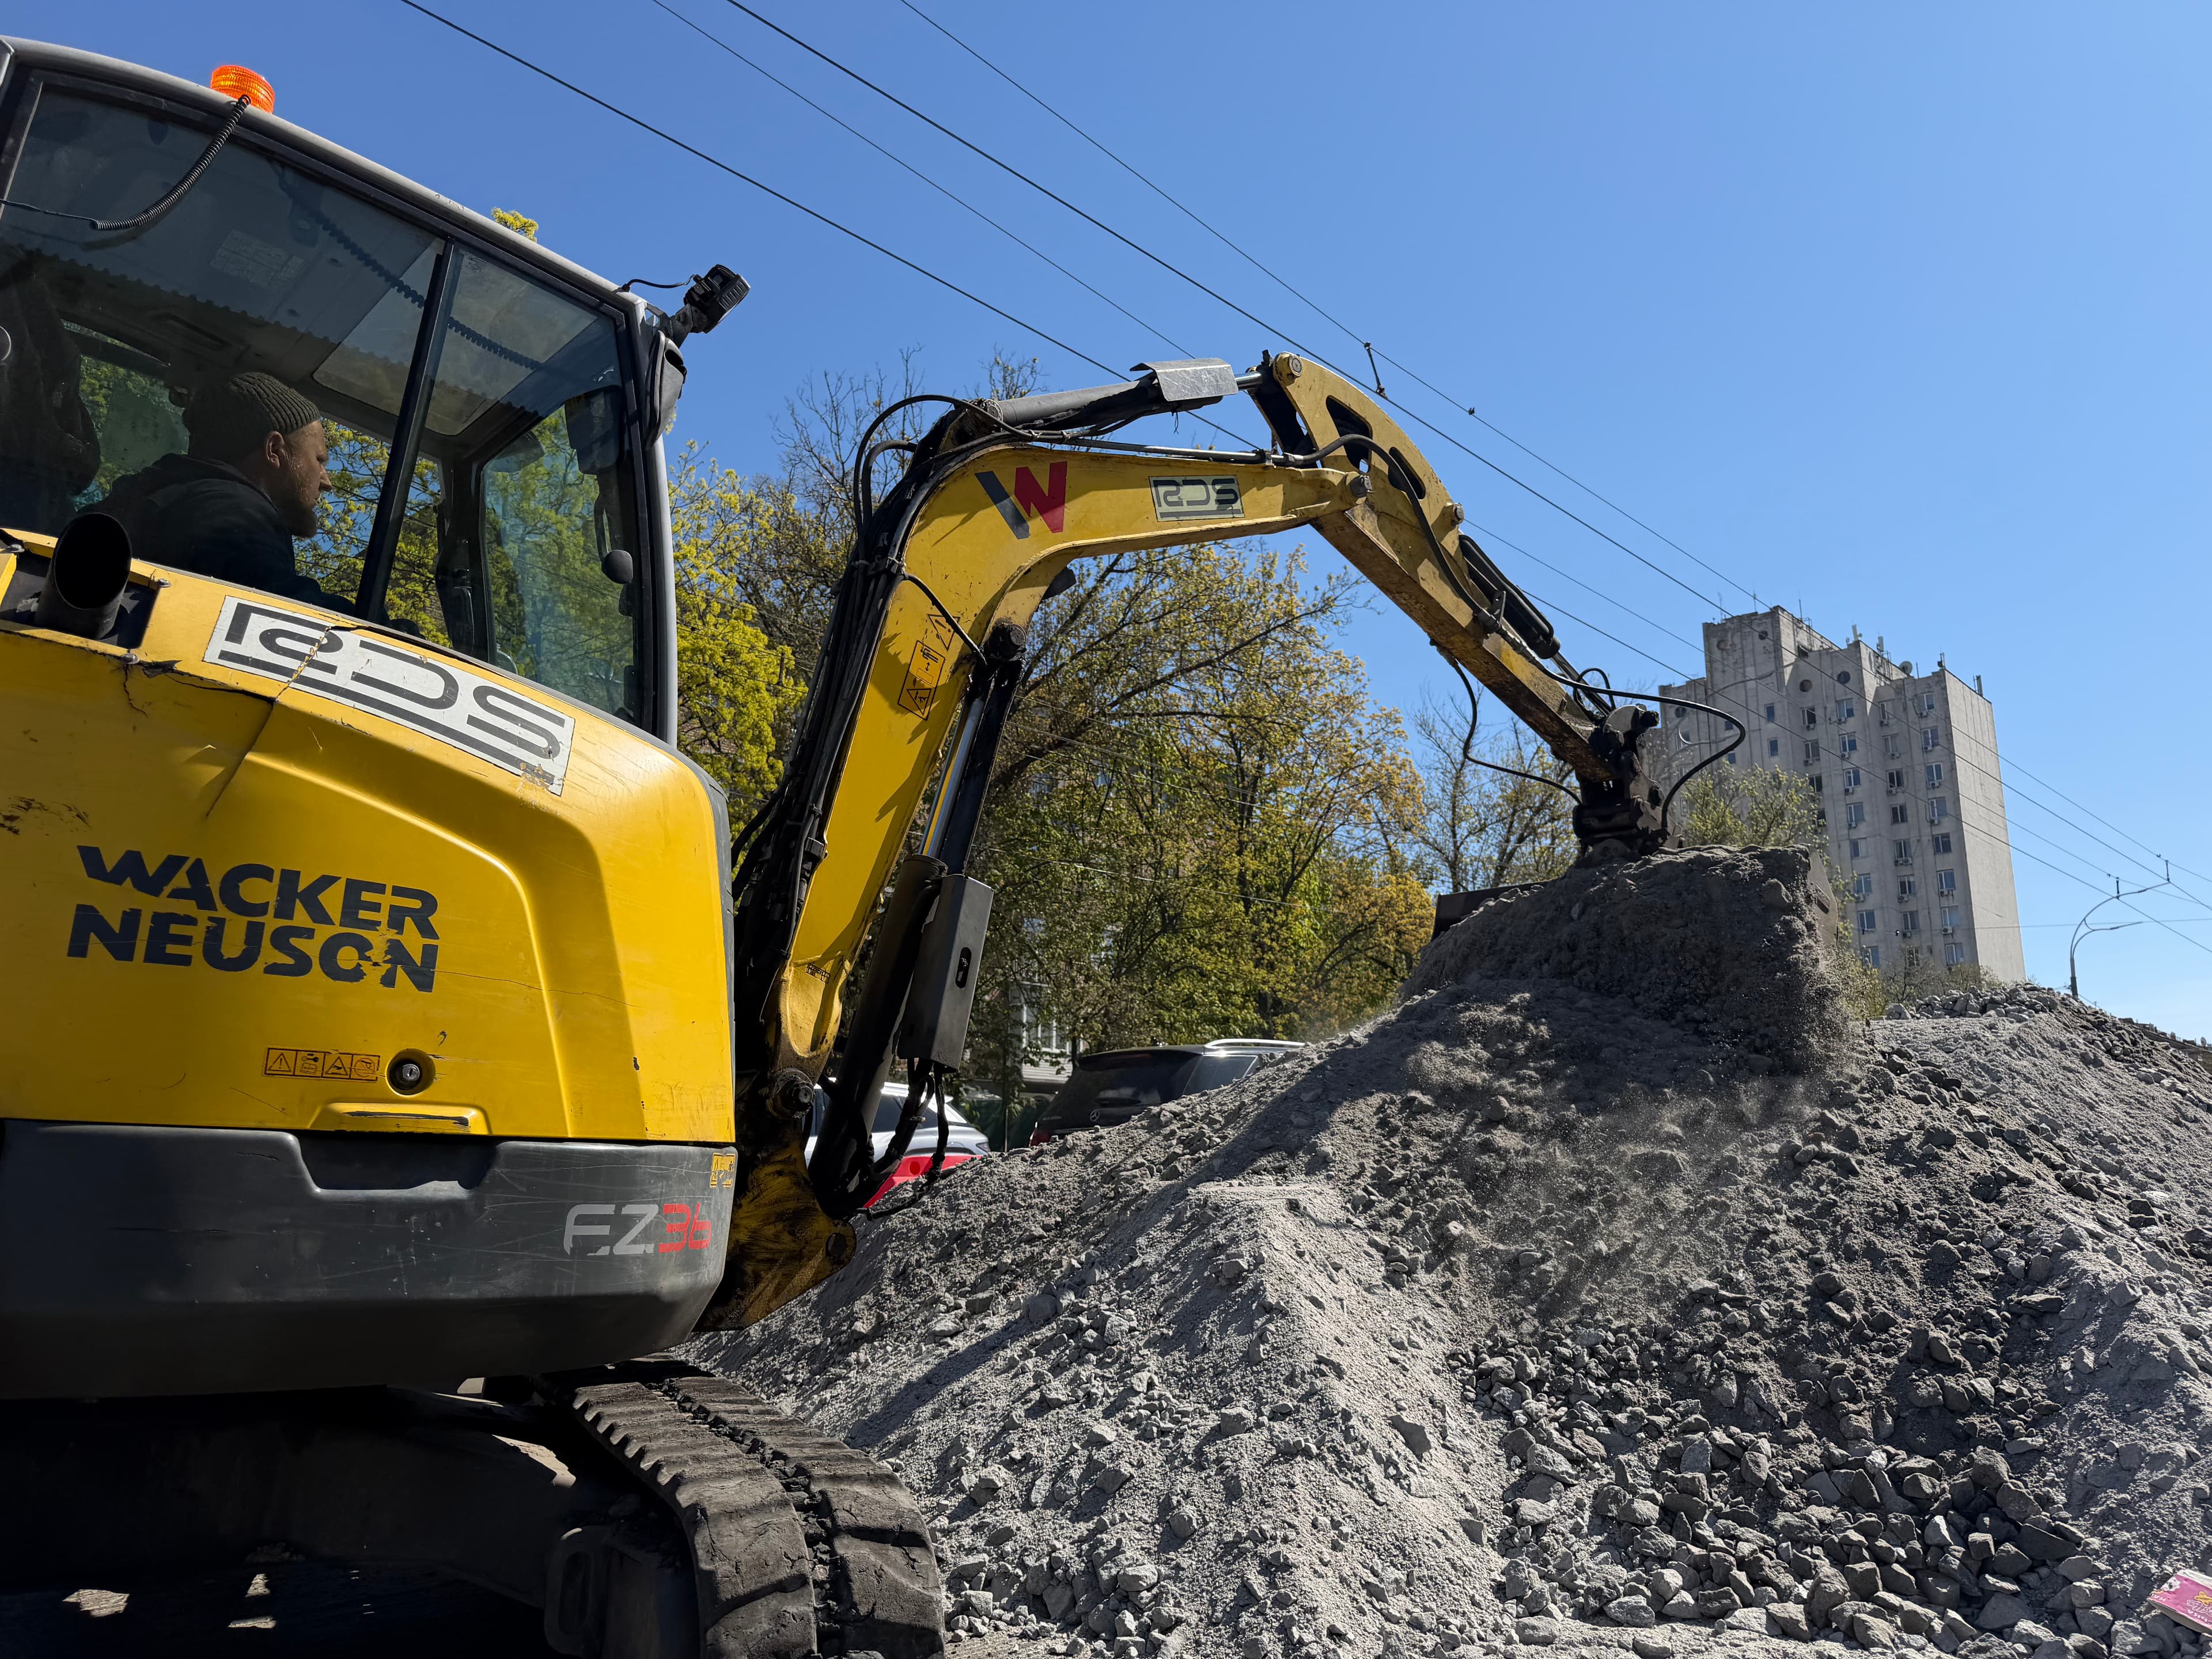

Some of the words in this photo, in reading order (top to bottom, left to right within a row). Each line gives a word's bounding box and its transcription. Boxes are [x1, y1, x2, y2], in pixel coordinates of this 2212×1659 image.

[1153, 478, 1238, 507] RDS
[77, 844, 440, 940] WACKER
[67, 903, 439, 993] NEUSON
[563, 1202, 712, 1256] EZ36
